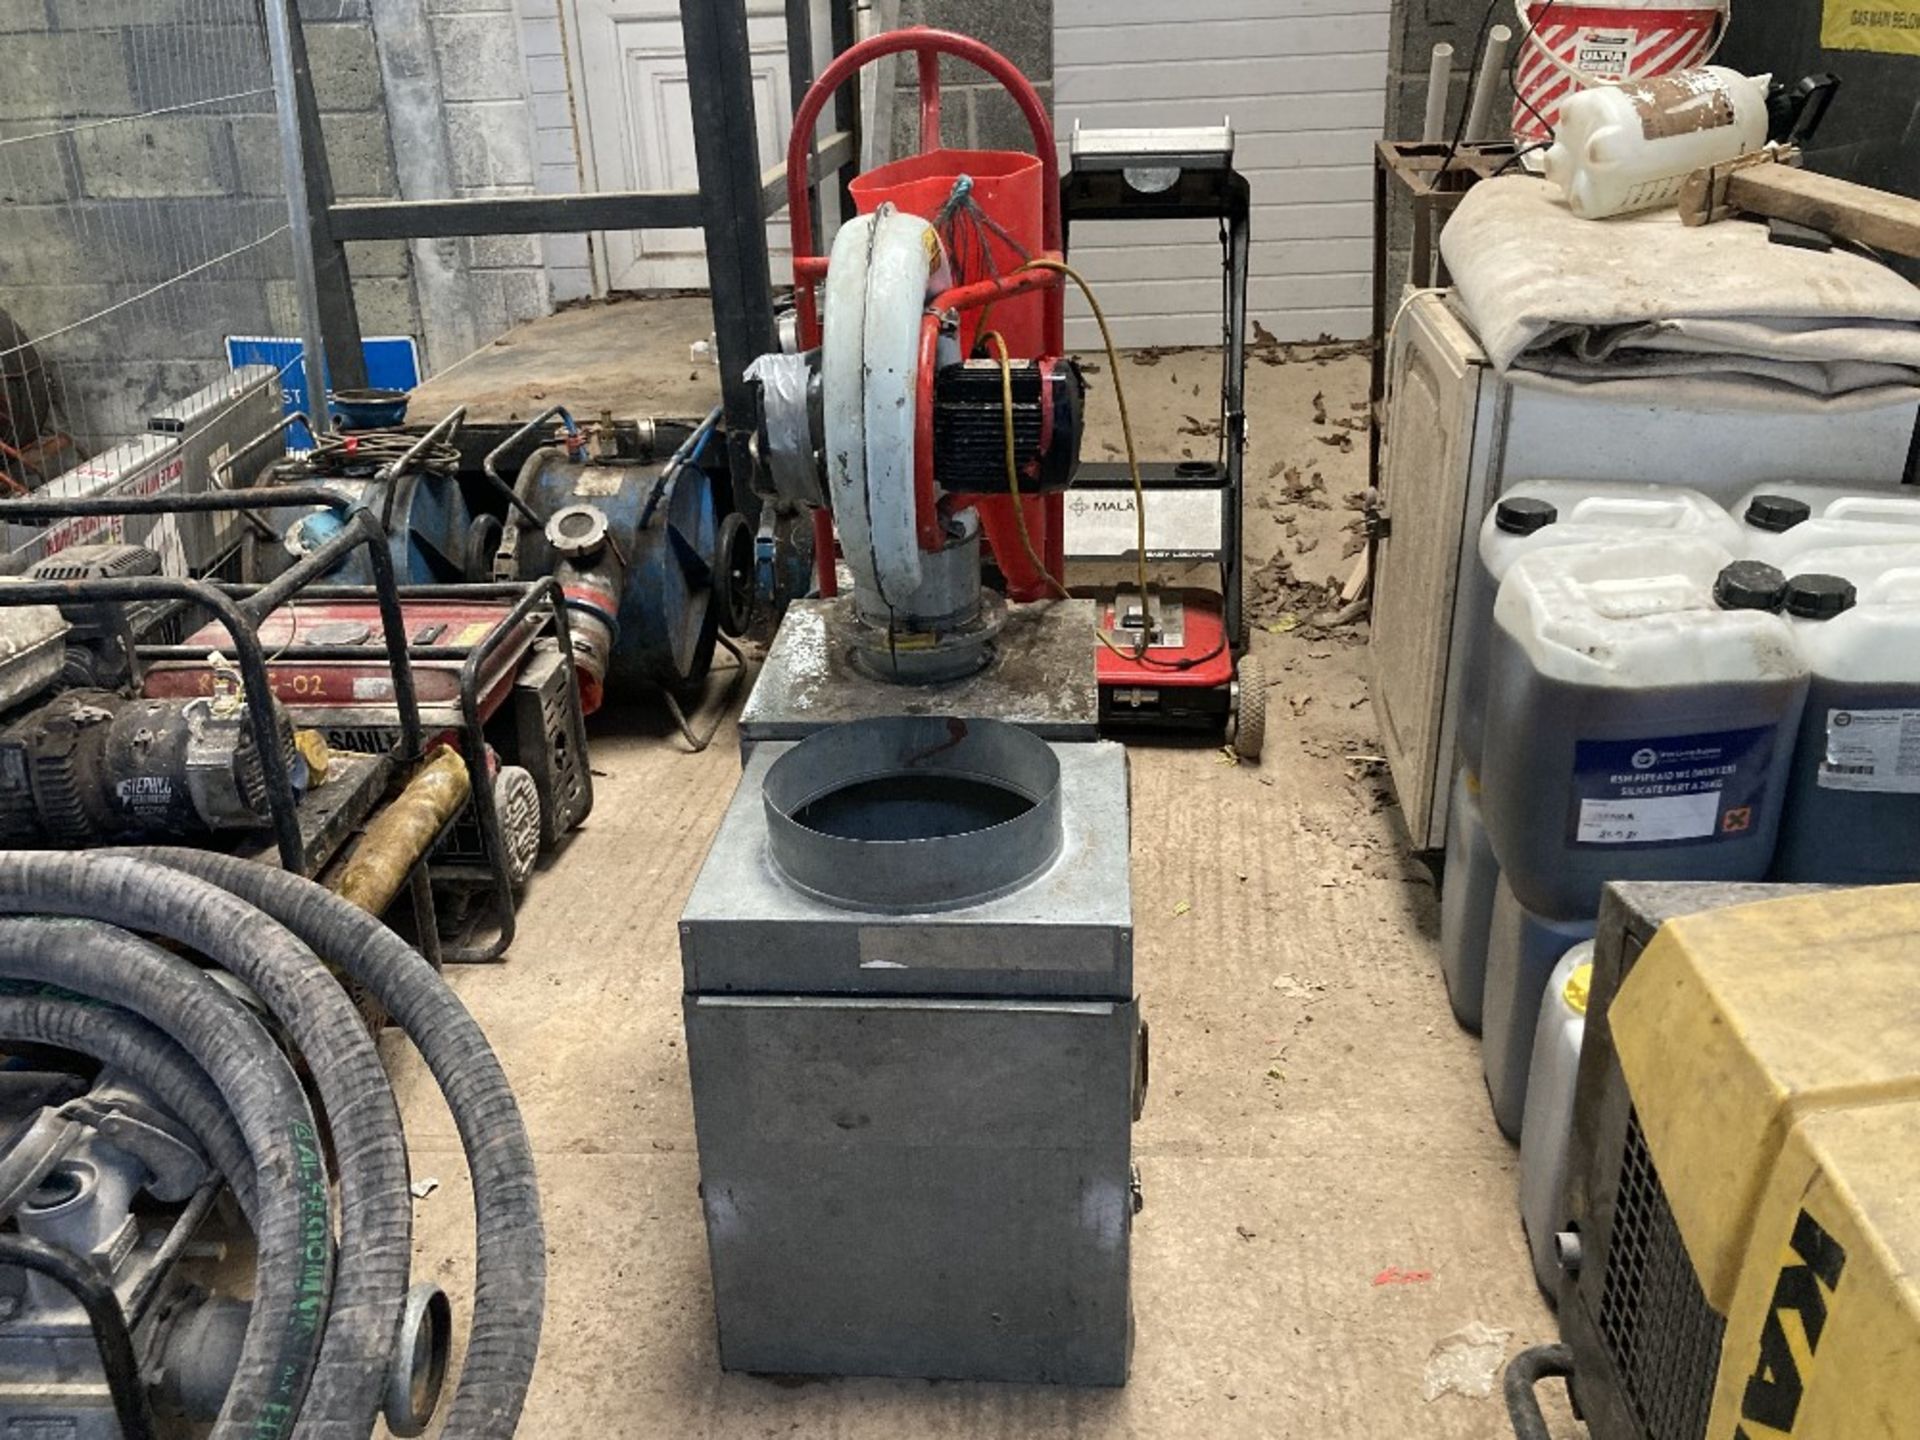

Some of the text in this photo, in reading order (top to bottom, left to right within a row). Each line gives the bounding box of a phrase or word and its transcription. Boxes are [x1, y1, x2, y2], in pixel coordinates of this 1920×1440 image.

[1851, 9, 1868, 26] GAS
[1580, 49, 1627, 62] ULTRA
[1621, 786, 1663, 796] SILICATE
[1665, 783, 1690, 793] PART
[1733, 1207, 1847, 1440] KA
